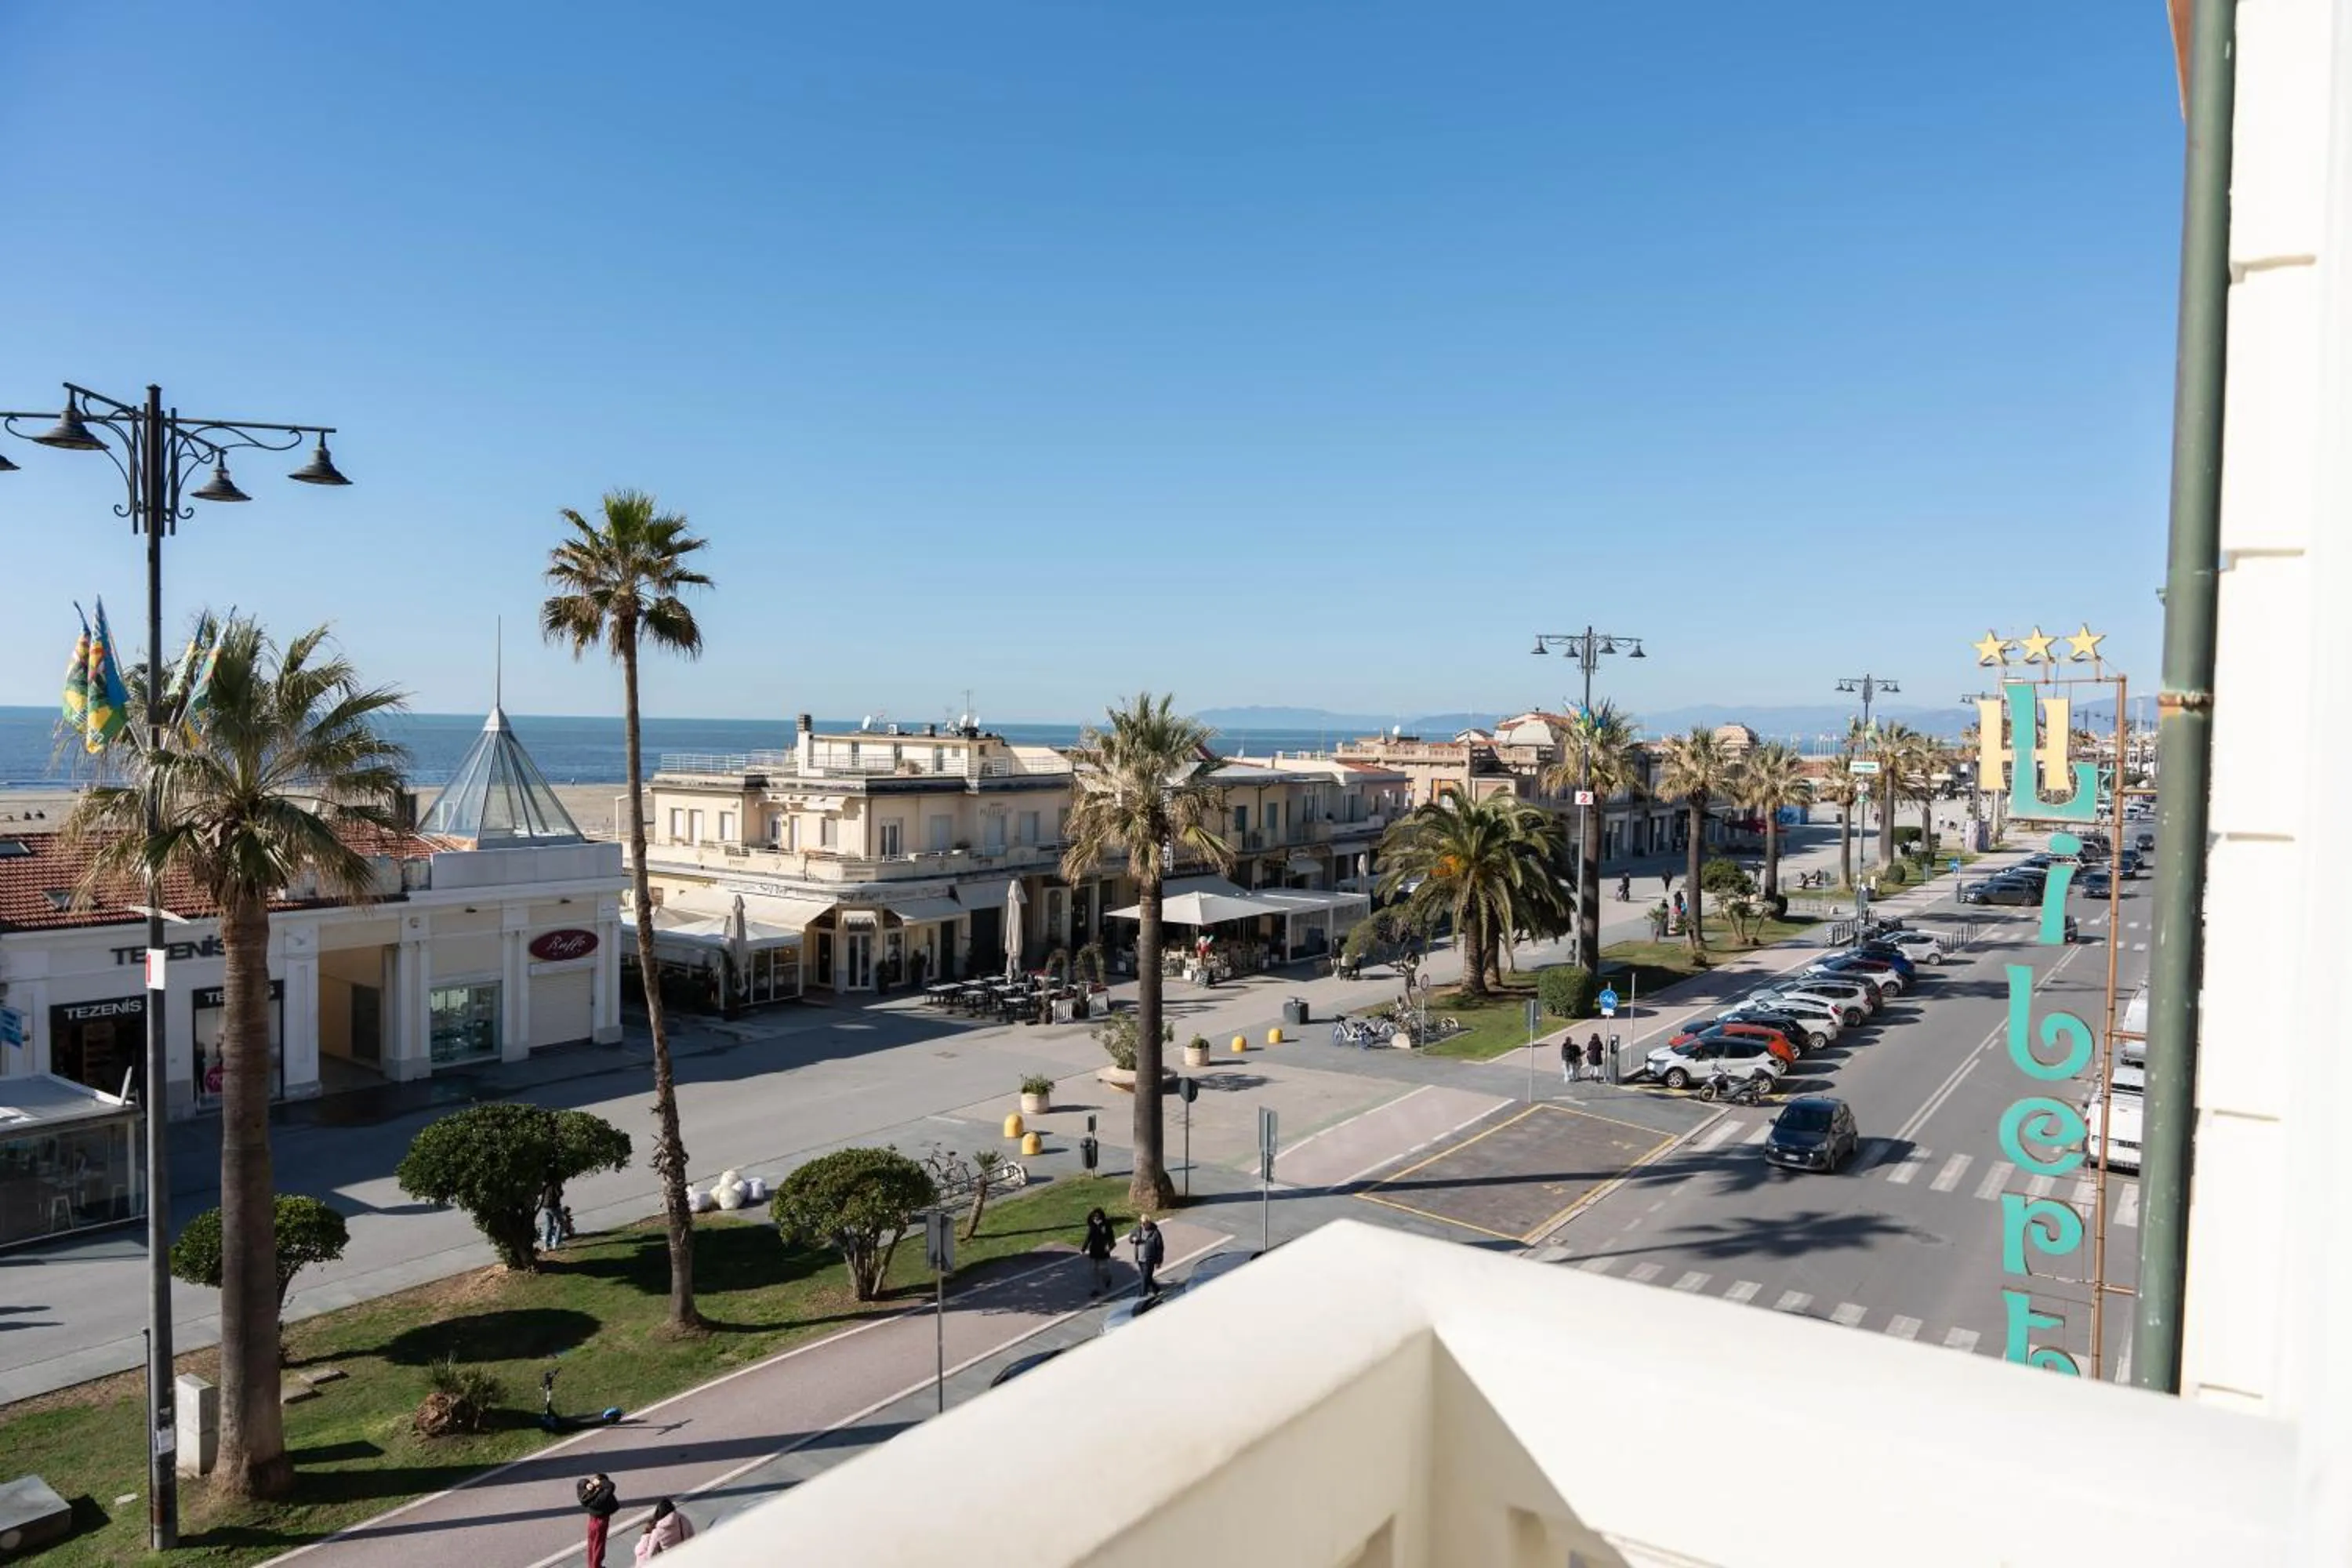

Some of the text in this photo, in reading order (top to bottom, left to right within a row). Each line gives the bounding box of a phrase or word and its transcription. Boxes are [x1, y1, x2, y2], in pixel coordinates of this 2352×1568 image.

[1580, 793, 1588, 804] 2
[110, 935, 227, 966] TEENIS
[64, 998, 143, 1021] TEZENIS
